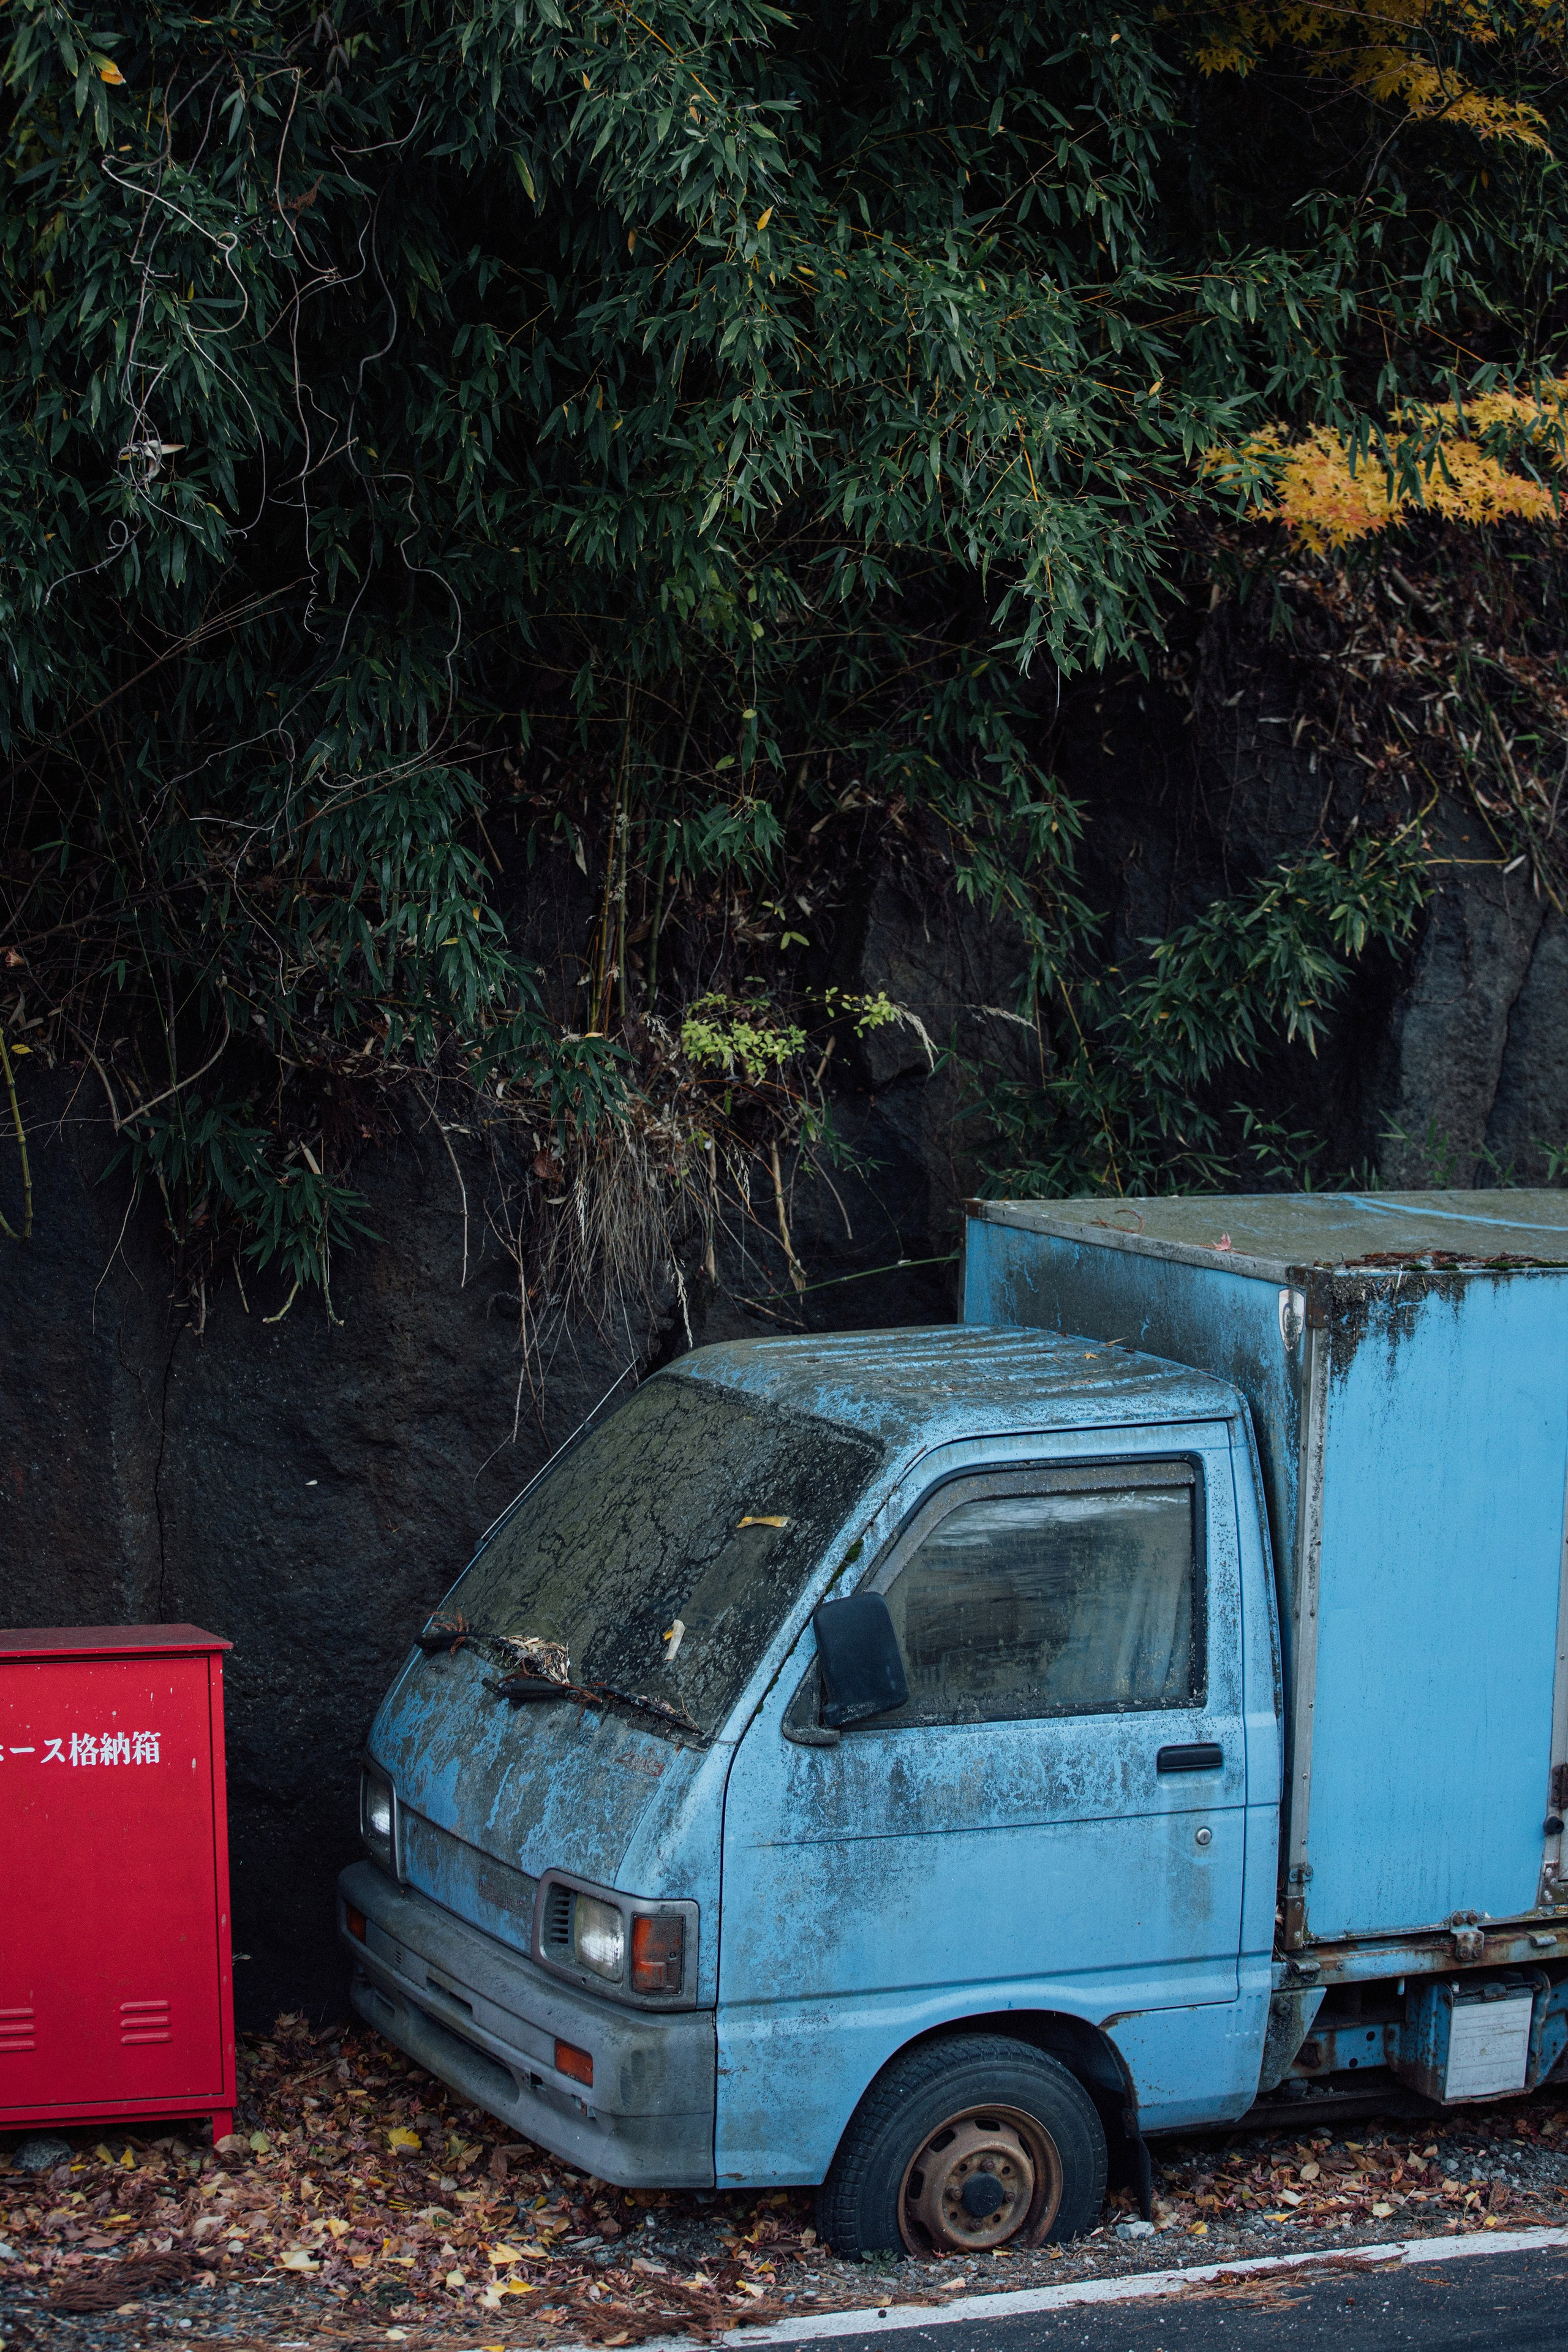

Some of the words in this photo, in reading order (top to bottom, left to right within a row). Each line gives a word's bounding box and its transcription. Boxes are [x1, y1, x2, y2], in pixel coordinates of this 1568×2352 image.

[0, 1731, 161, 1766] ース格納箱
